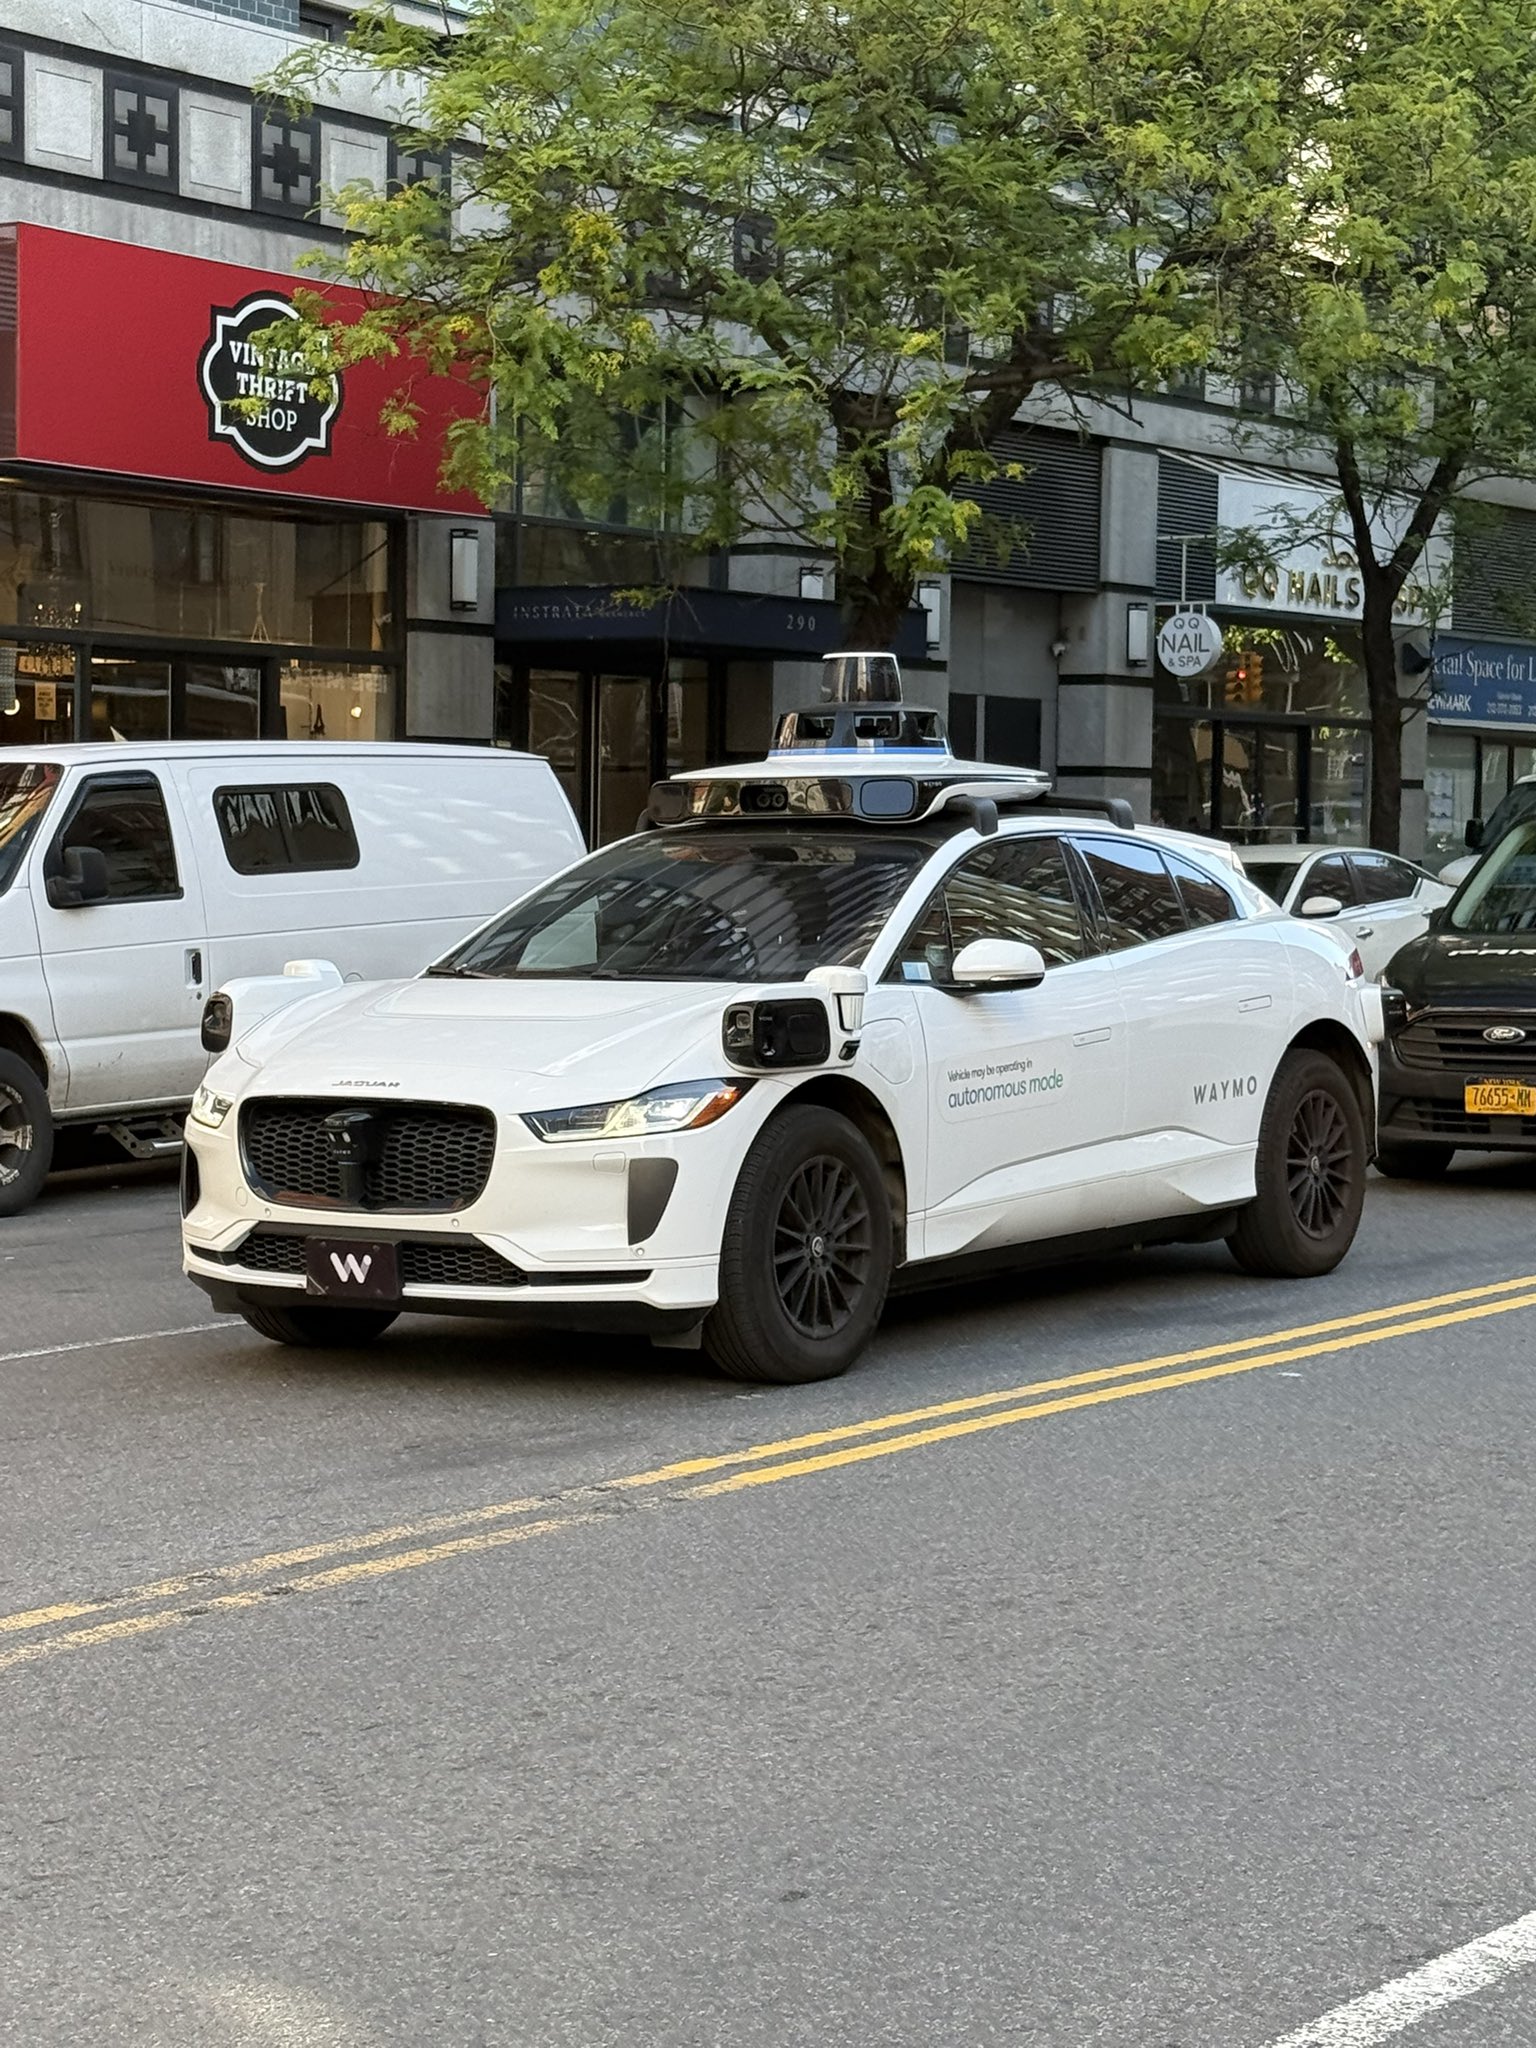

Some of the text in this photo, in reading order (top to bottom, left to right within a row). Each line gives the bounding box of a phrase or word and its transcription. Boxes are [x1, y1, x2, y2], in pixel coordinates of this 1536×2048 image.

[236, 372, 308, 404] THRIFT
[246, 408, 297, 432] SHOP
[1287, 570, 1360, 610] NAILS
[786, 614, 816, 631] 290
[1161, 633, 1210, 653] NAIL
[1168, 655, 1202, 668] & SPA
[1432, 652, 1463, 675] etail
[1466, 650, 1504, 687] Space
[1506, 654, 1526, 681] for
[947, 1058, 1033, 1083] Vehicle may be operating in
[948, 1068, 1064, 1109] autonomous mode
[1193, 1075, 1258, 1105] WAYMO
